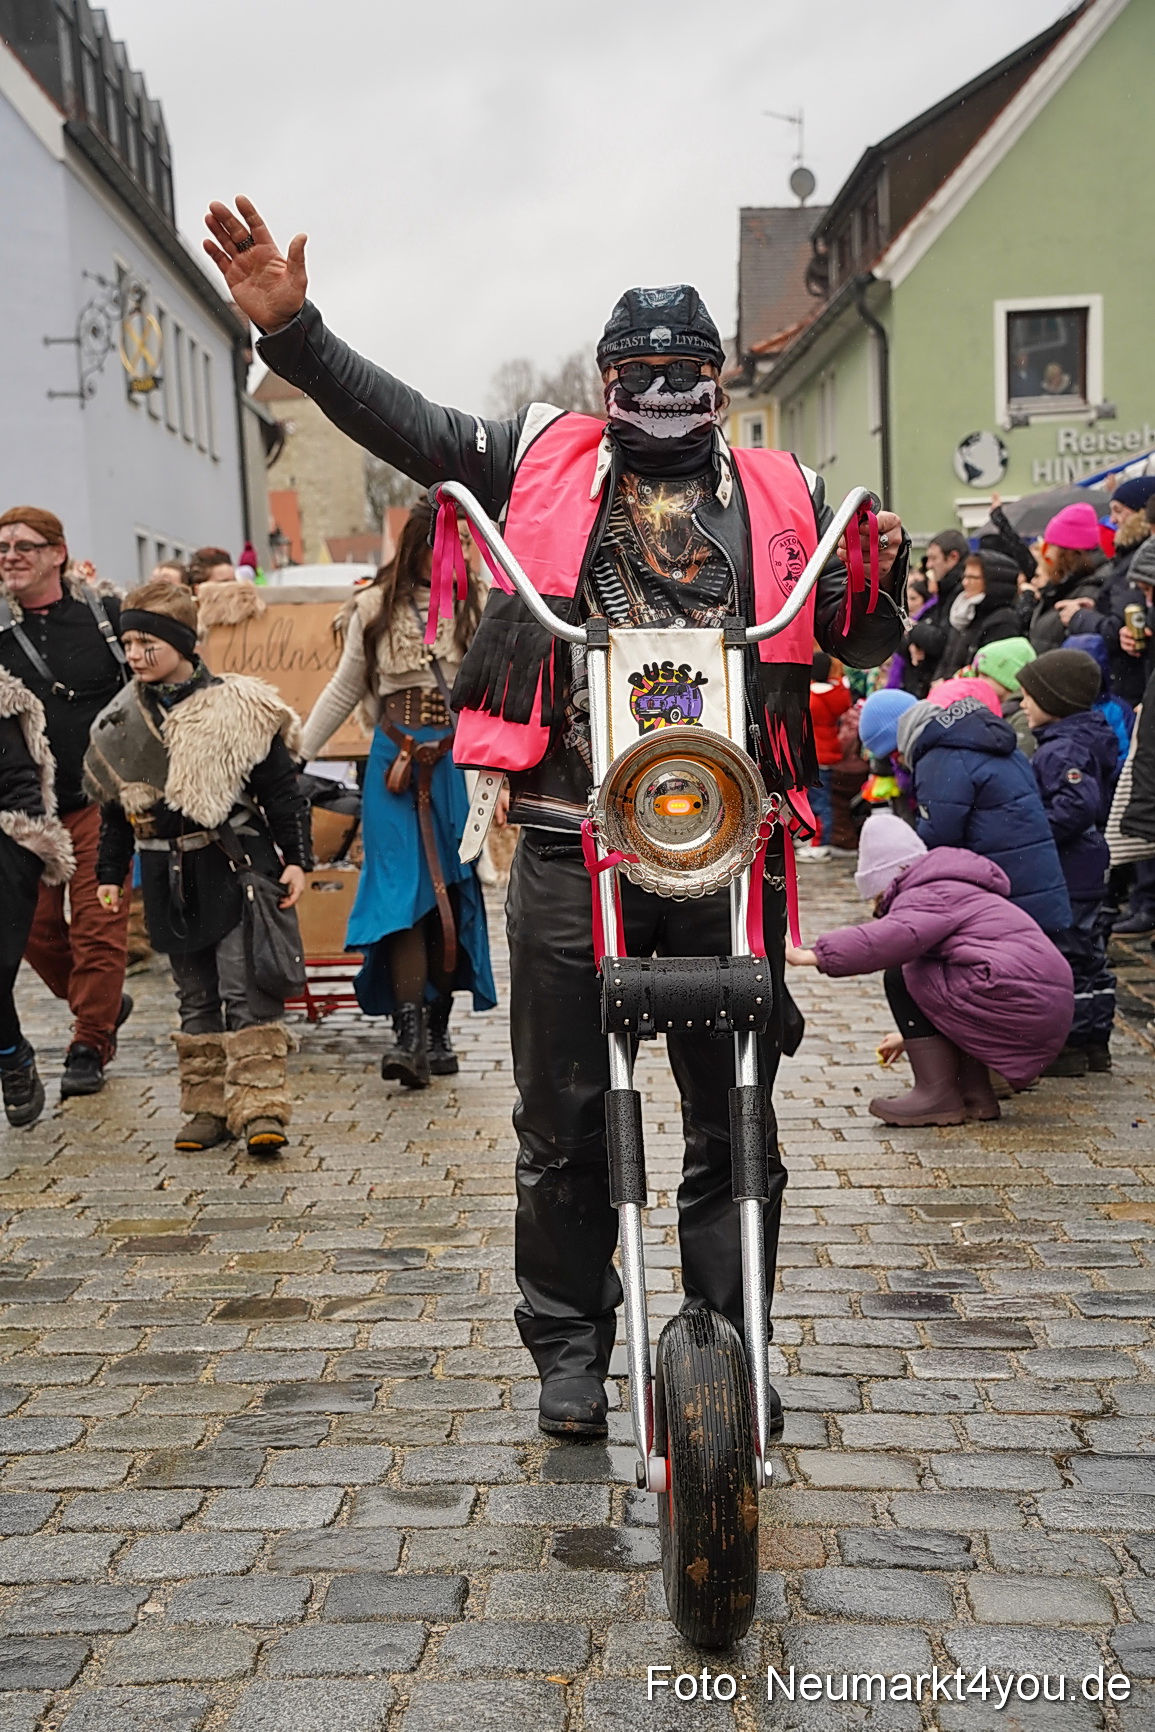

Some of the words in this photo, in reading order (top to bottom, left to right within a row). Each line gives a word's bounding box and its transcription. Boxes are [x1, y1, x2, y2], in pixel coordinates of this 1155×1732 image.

[619, 335, 646, 350] FAST
[675, 334, 701, 346] LIVE
[627, 660, 709, 690] PUSSY
